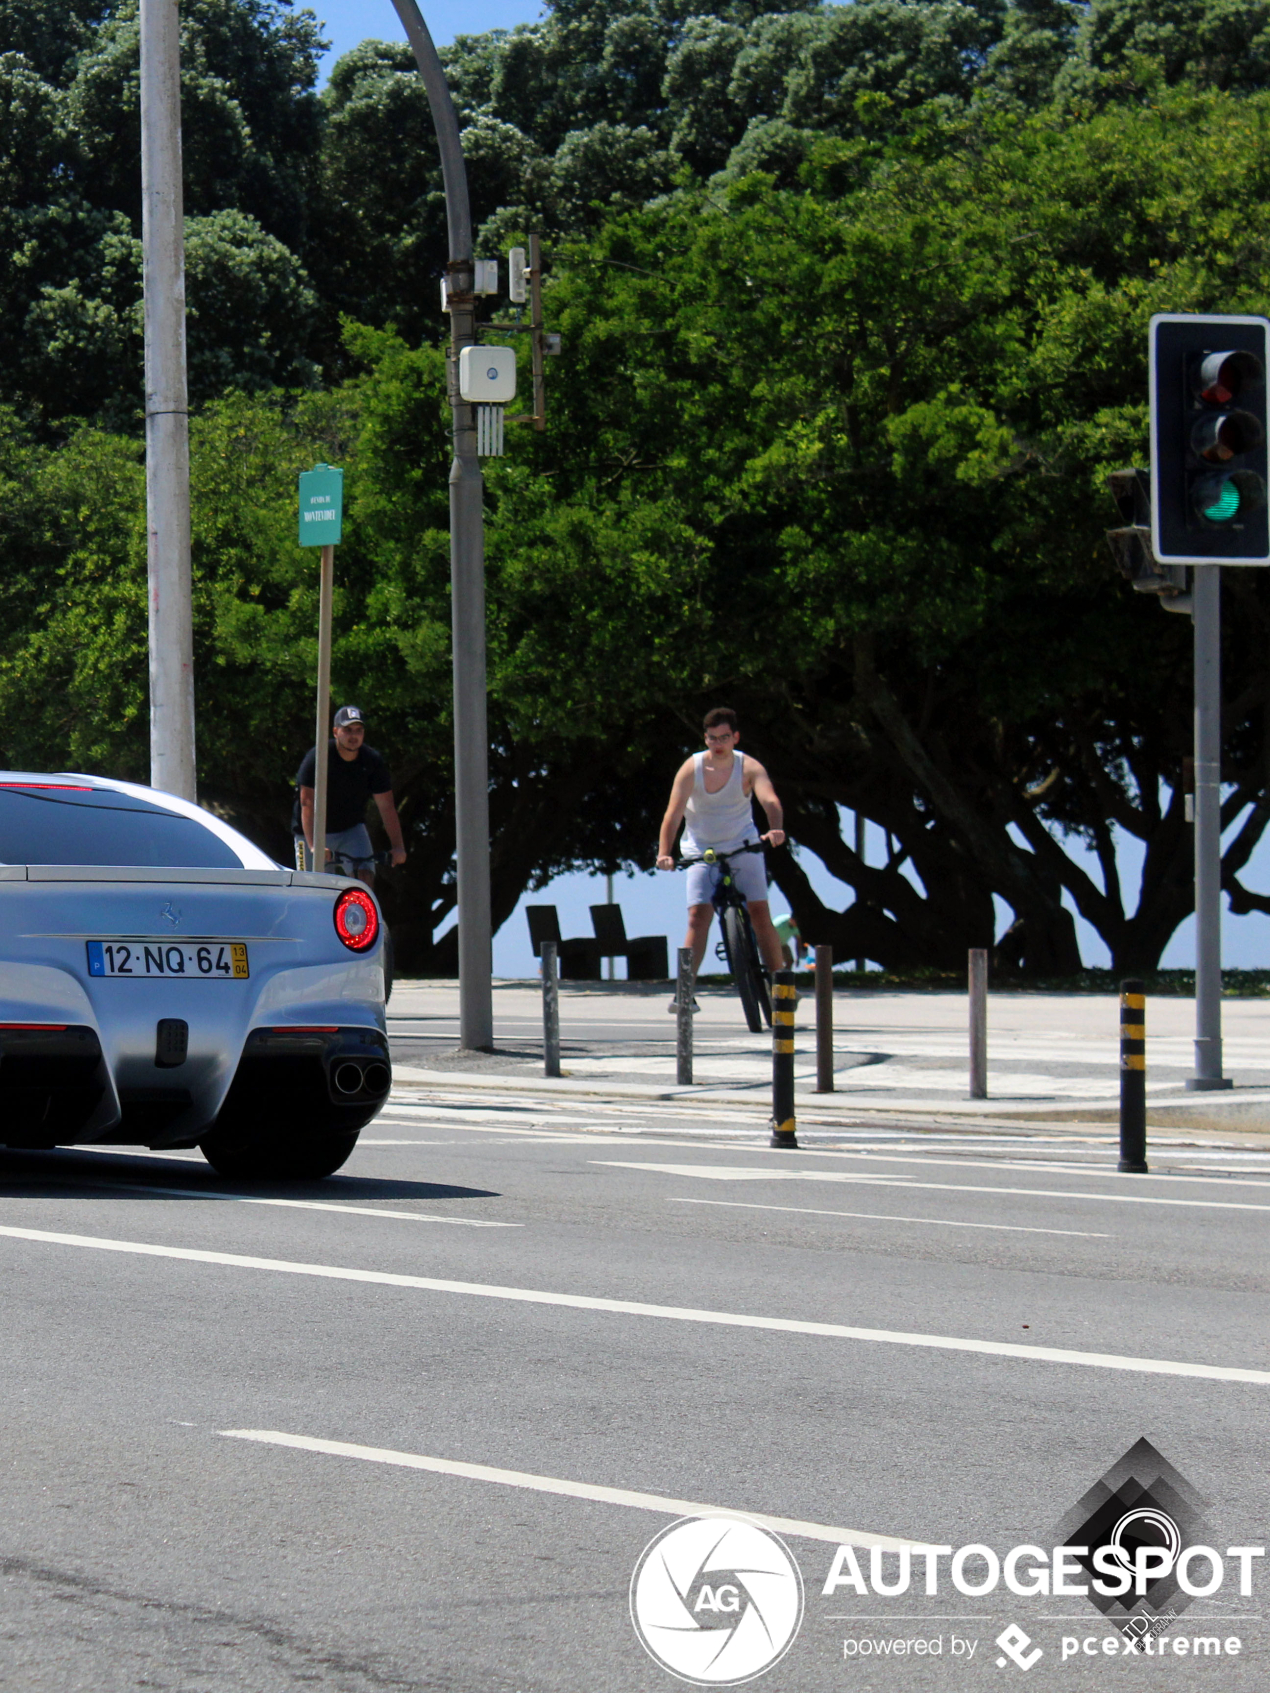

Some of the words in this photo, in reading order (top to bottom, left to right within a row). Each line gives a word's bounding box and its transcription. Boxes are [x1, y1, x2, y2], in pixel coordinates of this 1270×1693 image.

[233, 947, 245, 957] 13
[94, 962, 101, 970] P
[235, 964, 247, 975] 04
